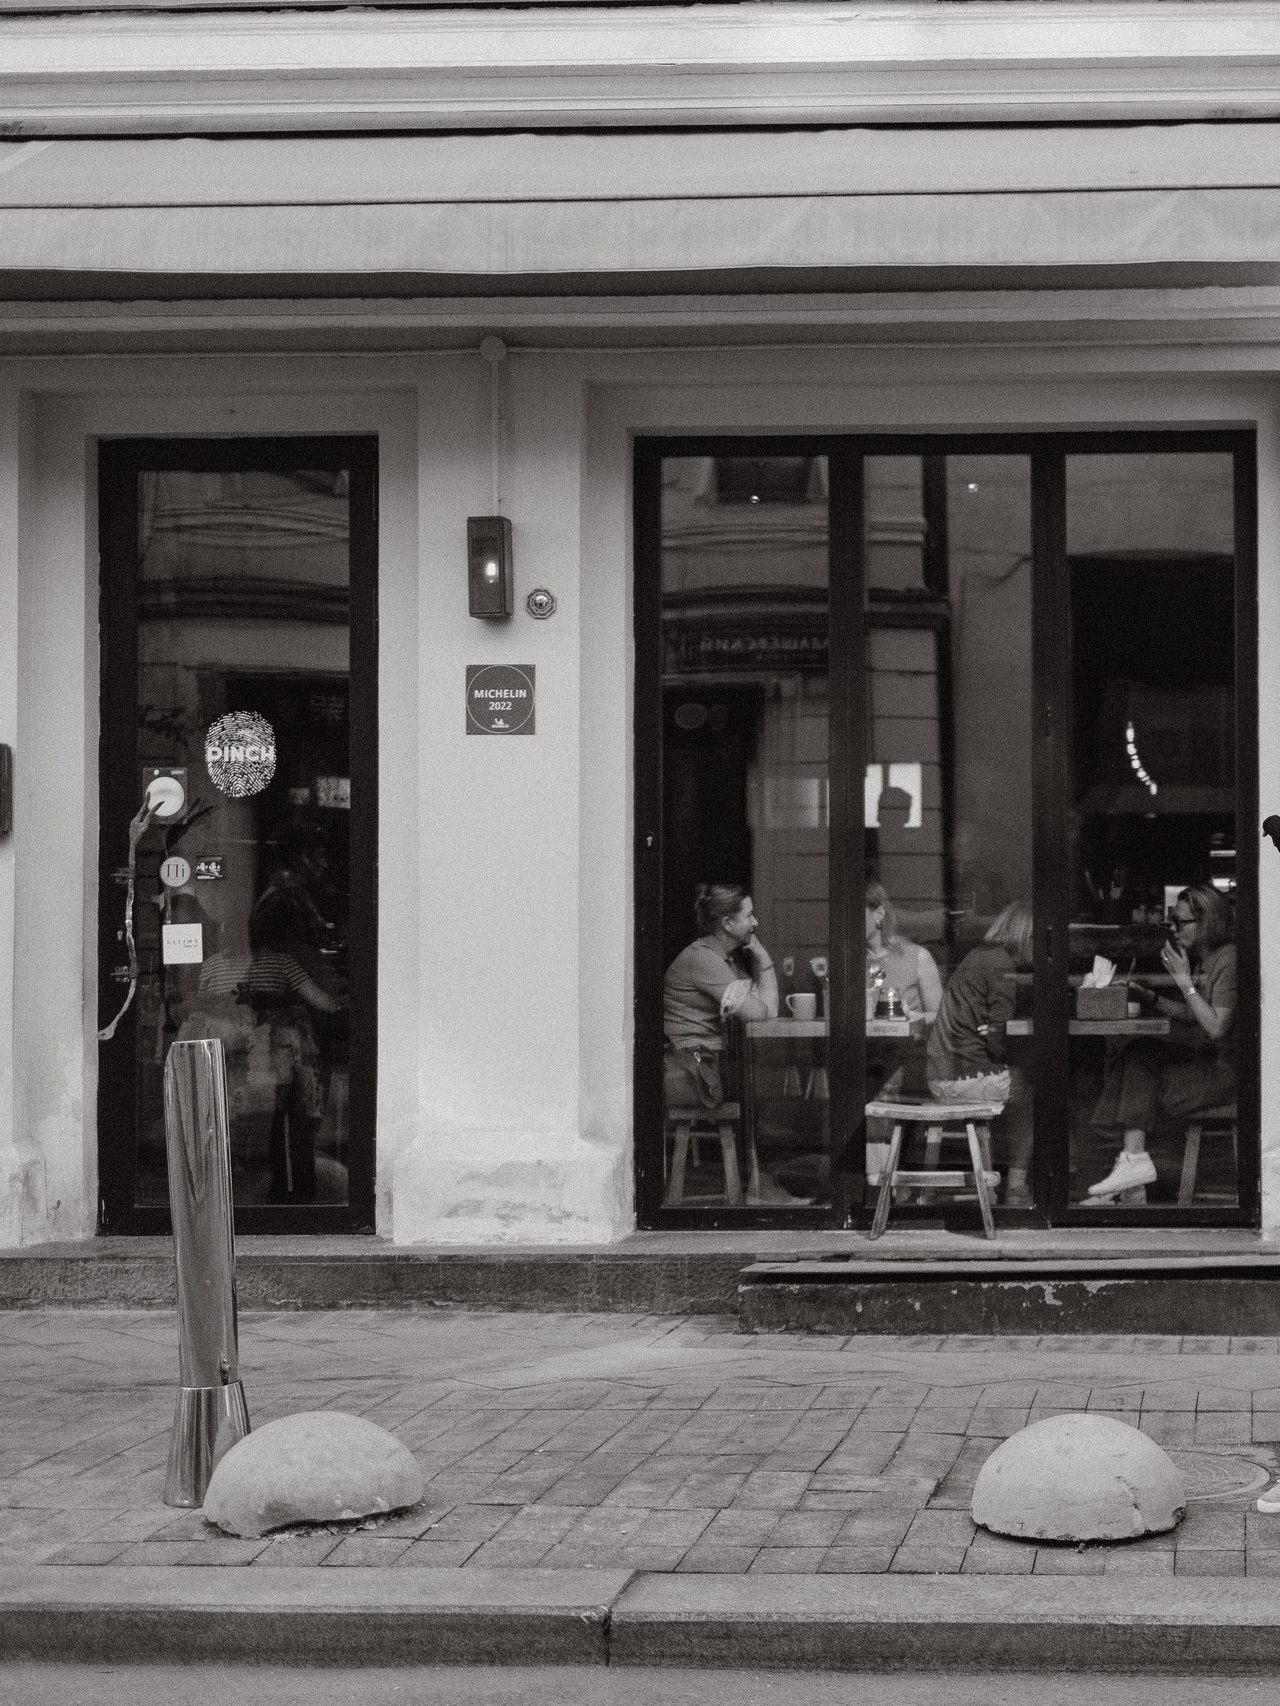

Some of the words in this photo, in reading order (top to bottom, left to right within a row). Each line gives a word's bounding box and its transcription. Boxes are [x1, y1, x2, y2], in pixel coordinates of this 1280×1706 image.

[474, 689, 527, 699] MICHELIN
[488, 701, 513, 711] 2022
[207, 745, 276, 762] PINCH
